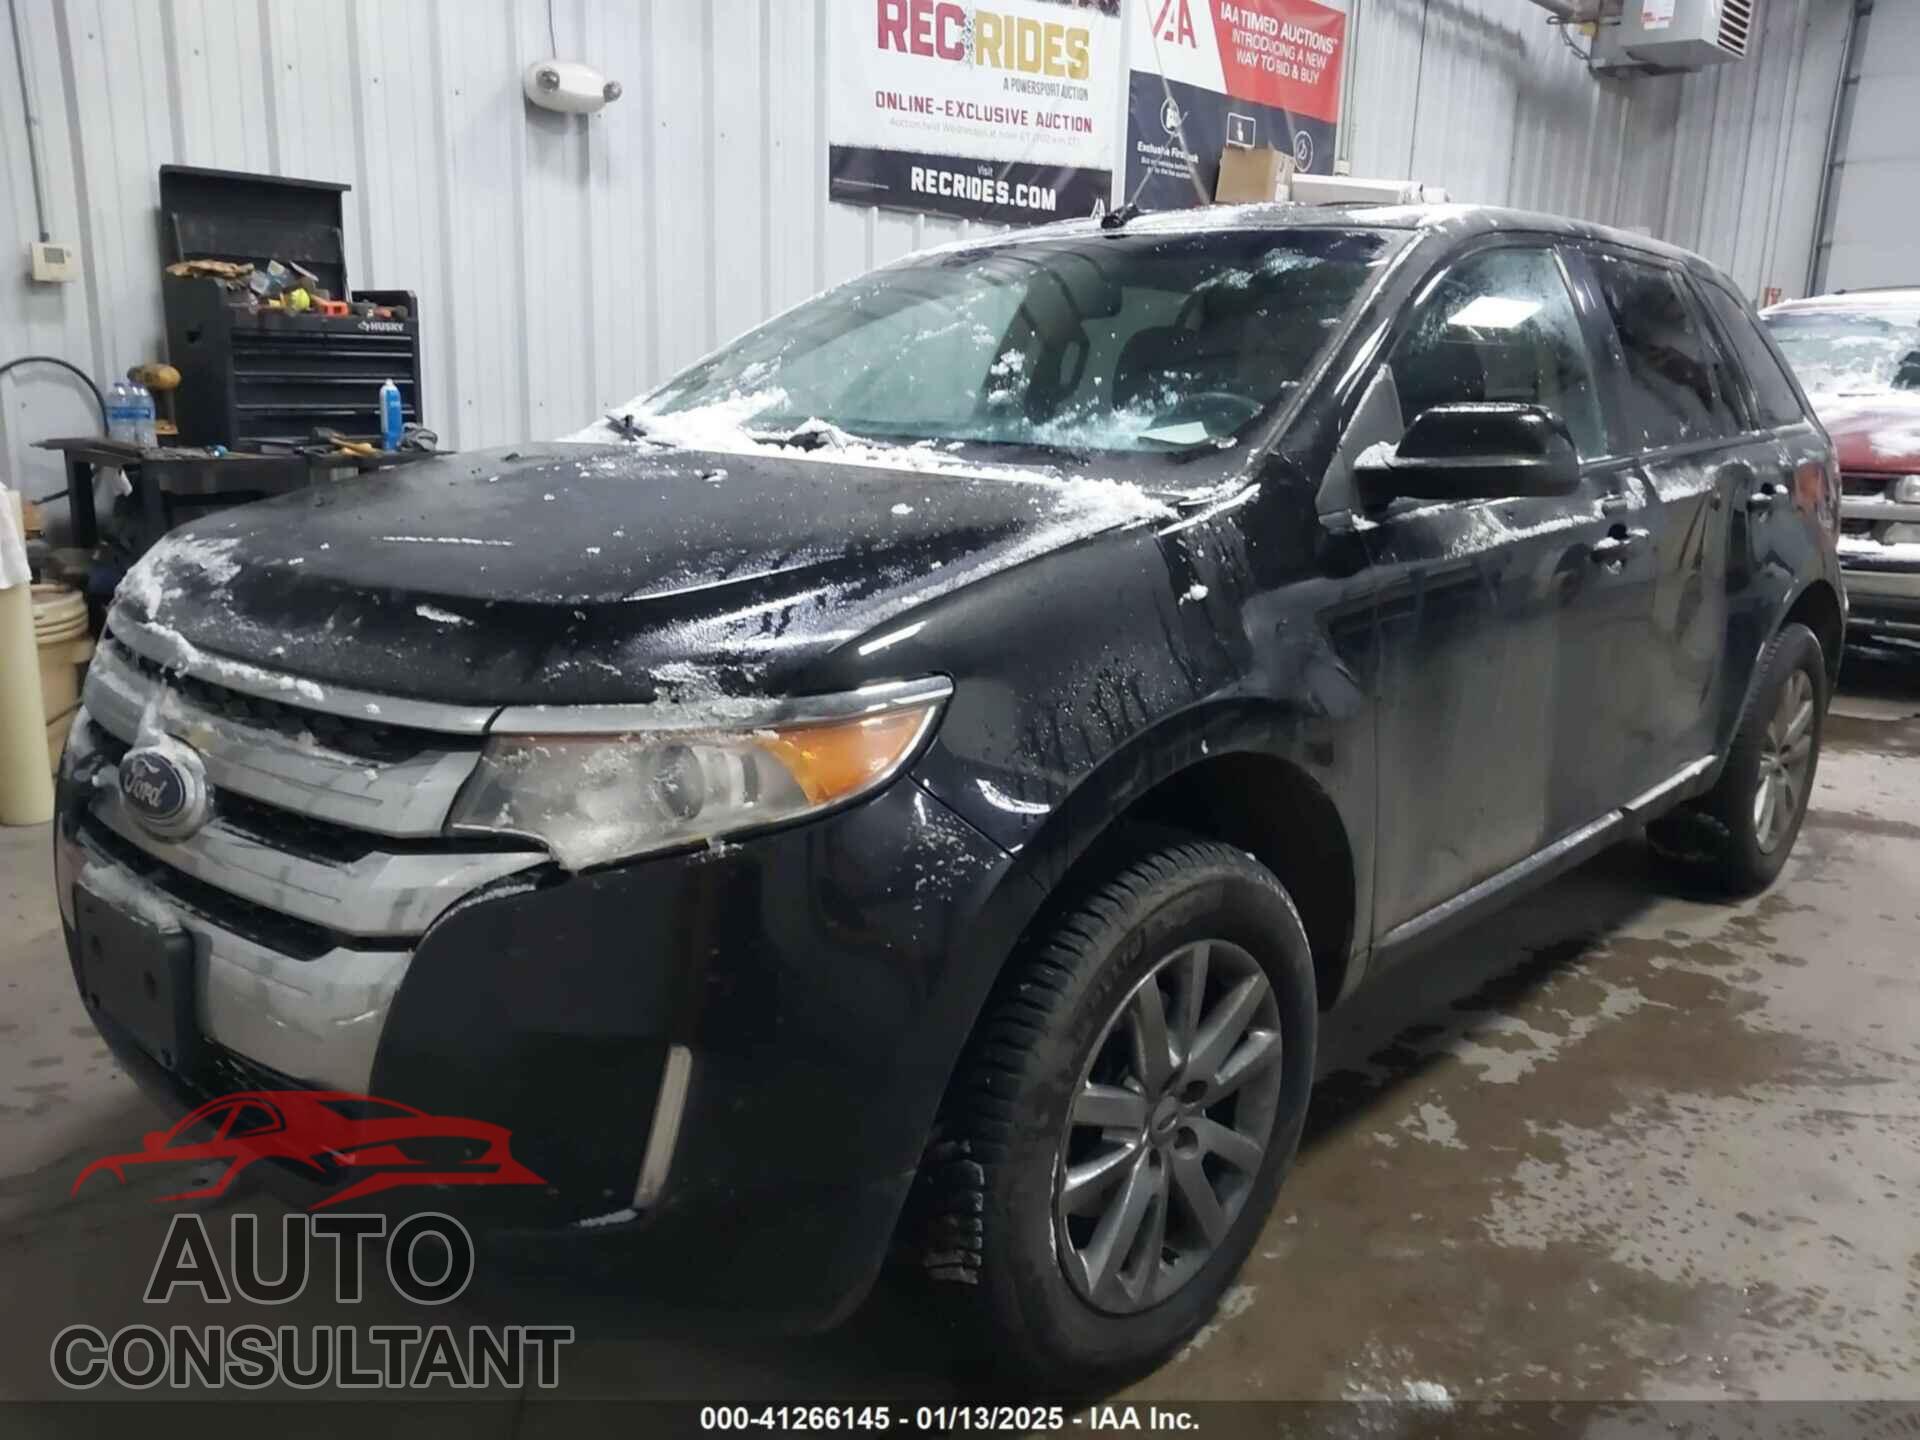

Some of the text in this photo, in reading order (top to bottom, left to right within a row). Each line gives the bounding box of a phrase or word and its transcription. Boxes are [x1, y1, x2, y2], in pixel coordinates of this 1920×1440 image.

[1220, 1, 1240, 25] IAA
[1240, 9, 1278, 36] TIMED
[1231, 28, 1327, 70] INTRODUCING A NEW
[1236, 48, 1320, 85] WAY TO BID & BUY
[1003, 77, 1089, 101] A POWERSPORT AUCTION
[875, 90, 1093, 134] ONLINE-EXCLUSIVE AUCTION
[911, 166, 1057, 212] RECRIDES.COM
[124, 757, 167, 808] Ford
